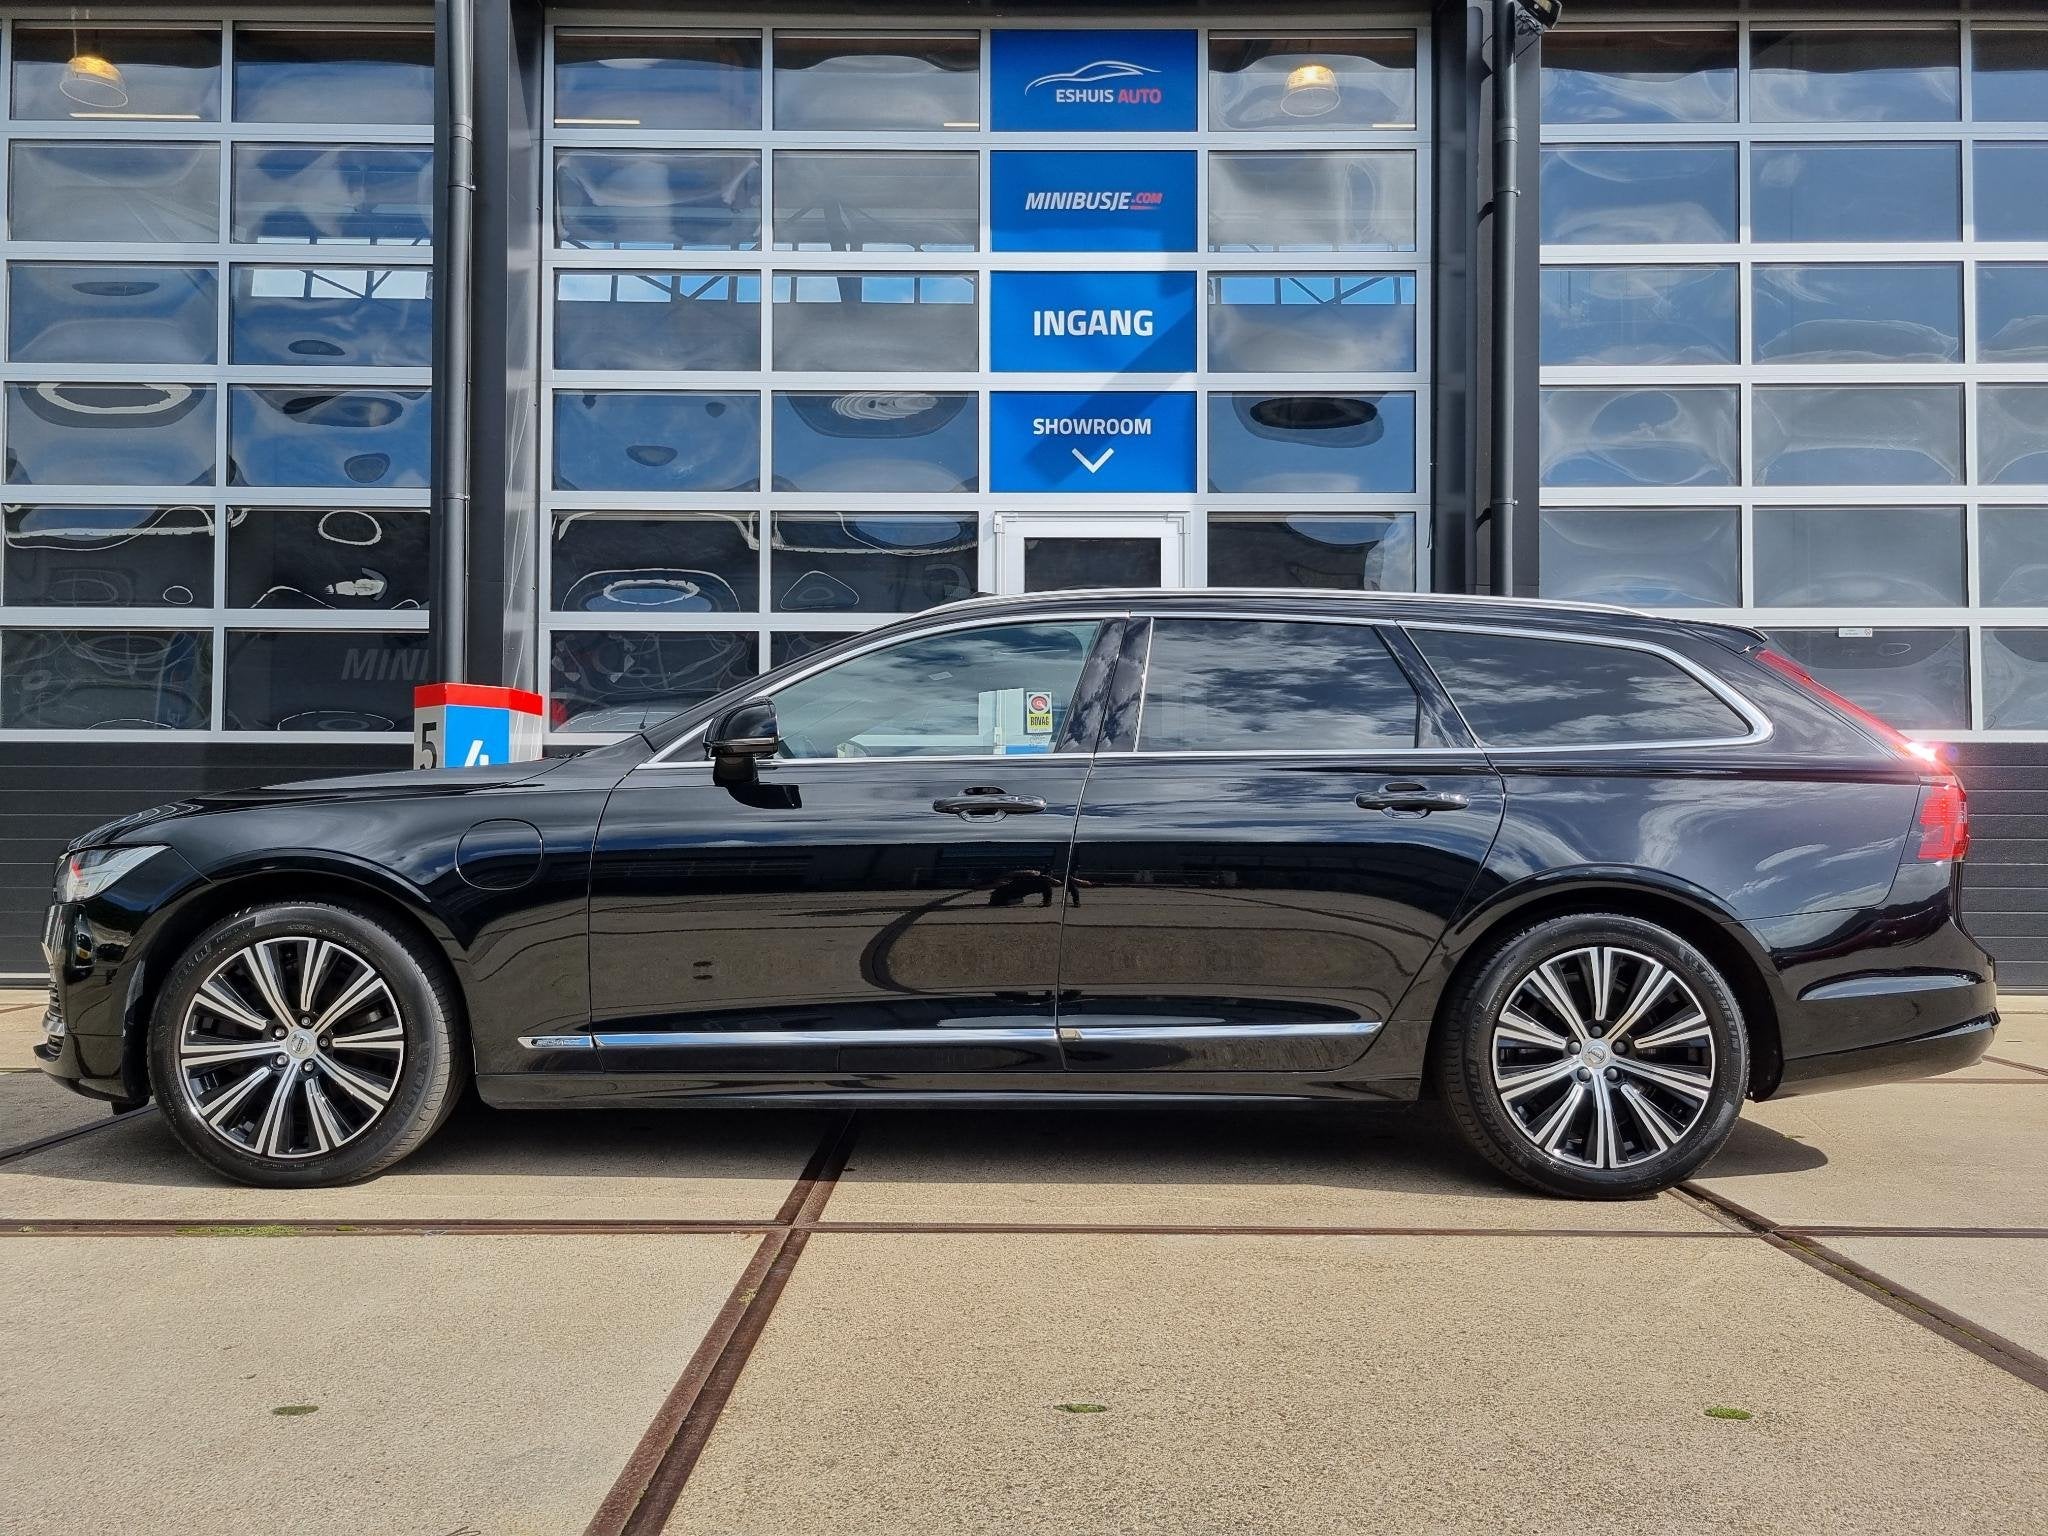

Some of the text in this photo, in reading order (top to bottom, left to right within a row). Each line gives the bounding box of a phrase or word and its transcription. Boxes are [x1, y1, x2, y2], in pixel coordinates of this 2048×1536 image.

[1055, 88, 1162, 104] ESHUIS AUTO
[1025, 191, 1163, 211] MINIBUSJE.COM
[1033, 310, 1154, 337] INGANG
[1032, 418, 1152, 436] SHOWROOM
[420, 722, 437, 769] 5
